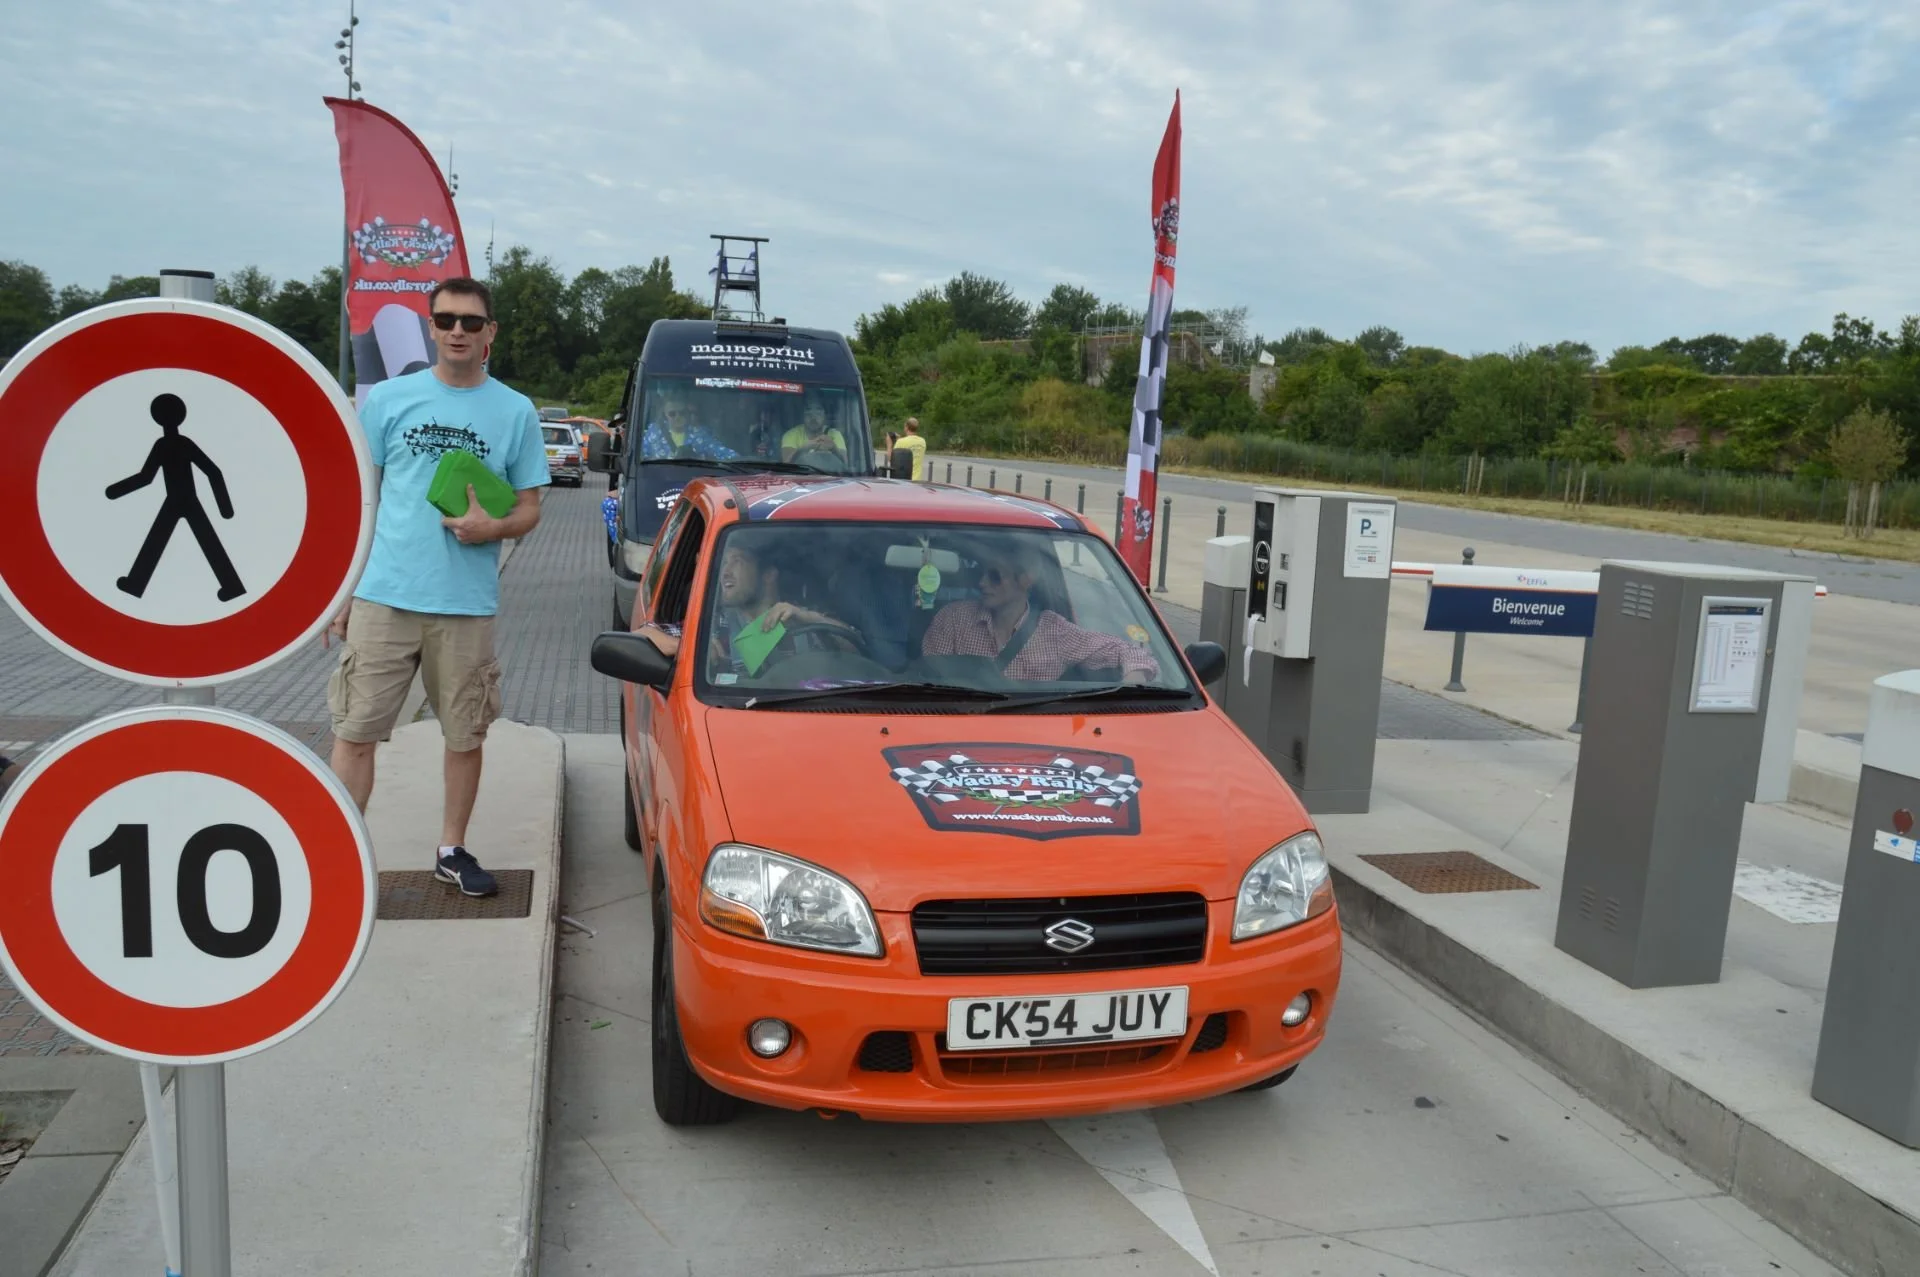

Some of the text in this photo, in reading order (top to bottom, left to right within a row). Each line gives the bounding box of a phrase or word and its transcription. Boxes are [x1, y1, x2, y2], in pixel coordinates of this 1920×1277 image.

[690, 343, 815, 360] maineprint
[1360, 518, 1371, 535] P
[1526, 578, 1548, 587] EFFIA
[1492, 597, 1565, 616] Bienvenue
[1509, 616, 1545, 627] Welcome
[940, 772, 1100, 794] Wacky Rally
[952, 812, 1114, 824] www.wackyrally.co.uk
[88, 823, 282, 959] 10
[966, 992, 1173, 1041] CK54 JUY
